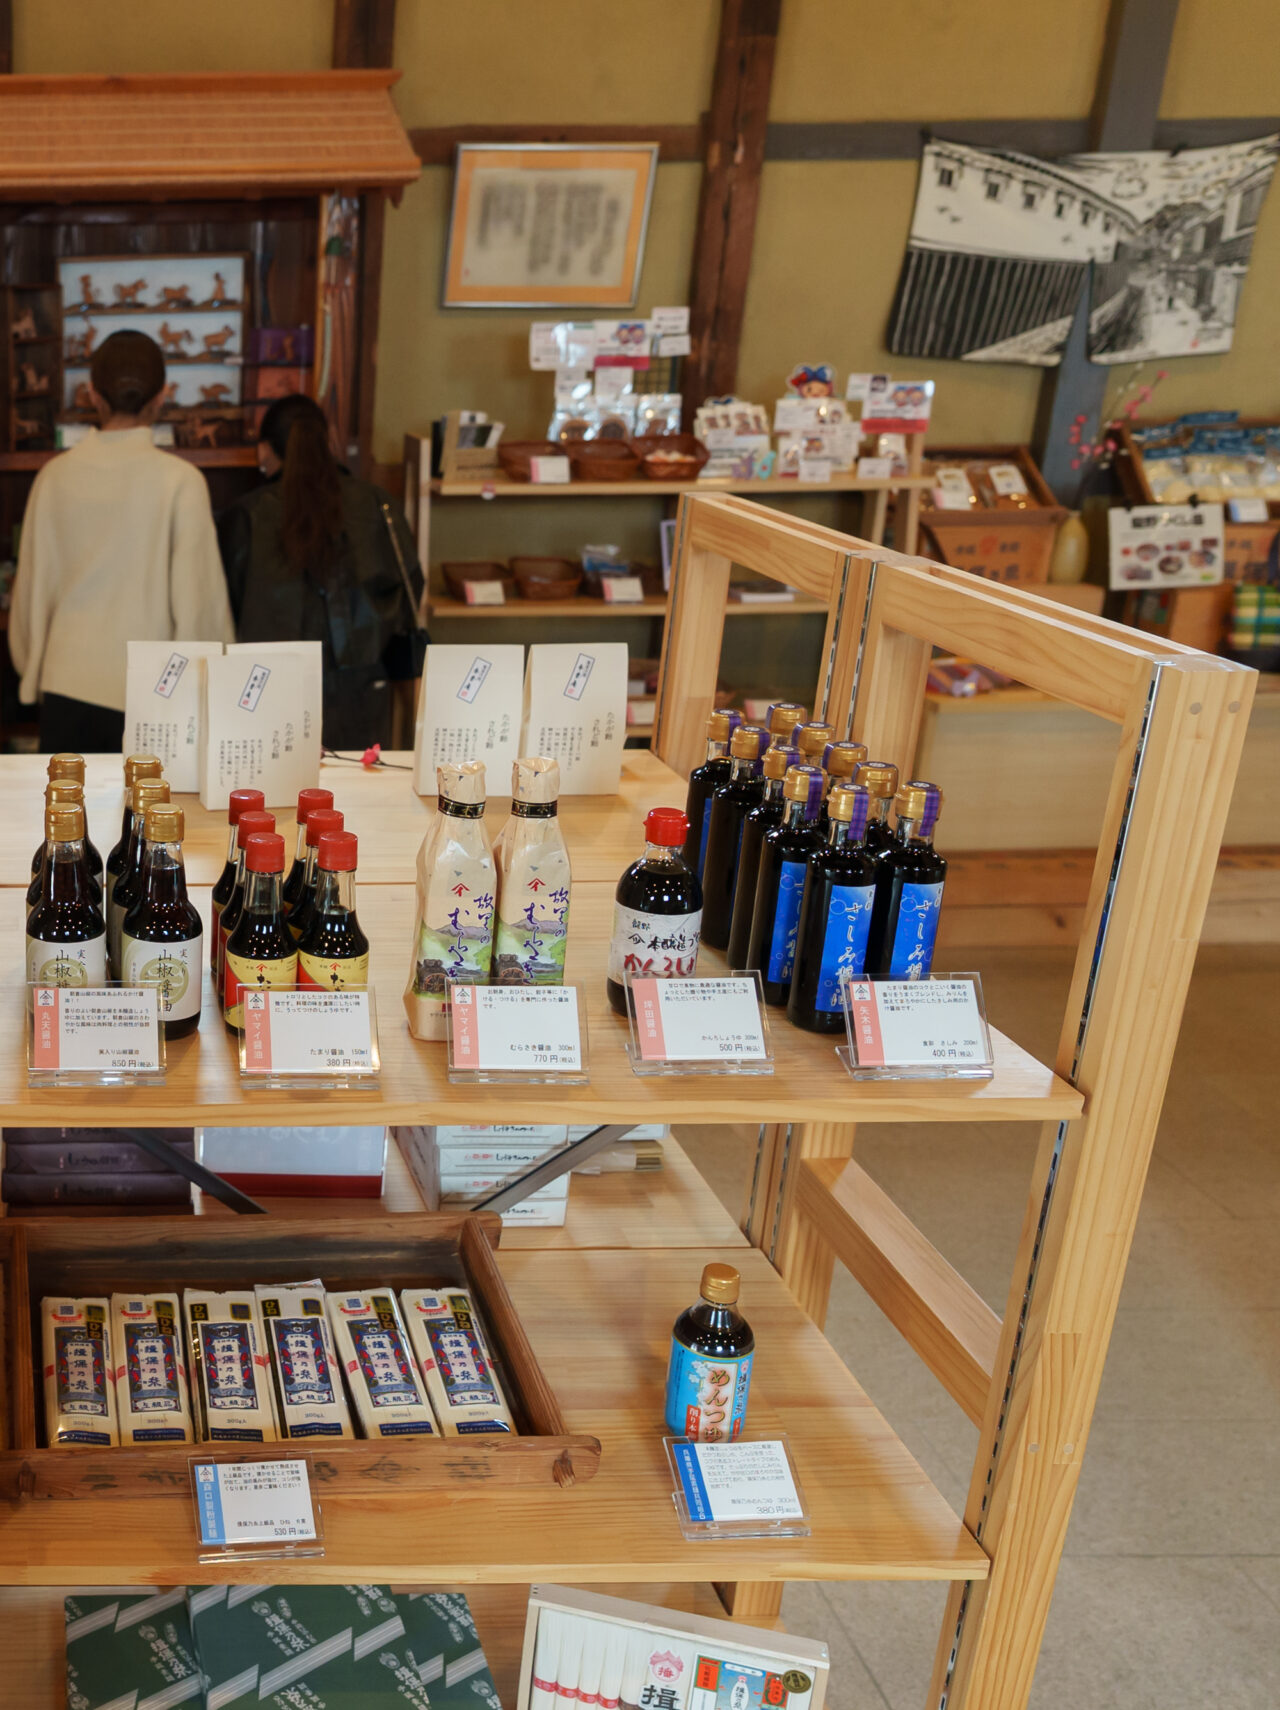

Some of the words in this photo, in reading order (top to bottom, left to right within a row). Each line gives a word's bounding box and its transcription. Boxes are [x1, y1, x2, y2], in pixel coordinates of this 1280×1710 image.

[41, 1012, 51, 1049] 丸天醤油
[252, 1013, 264, 1059] ヤマイ醤油
[459, 1007, 470, 1055] ヤマイ醤油
[510, 1043, 551, 1052] むらさき醤油
[310, 1048, 345, 1056] たまり醤油
